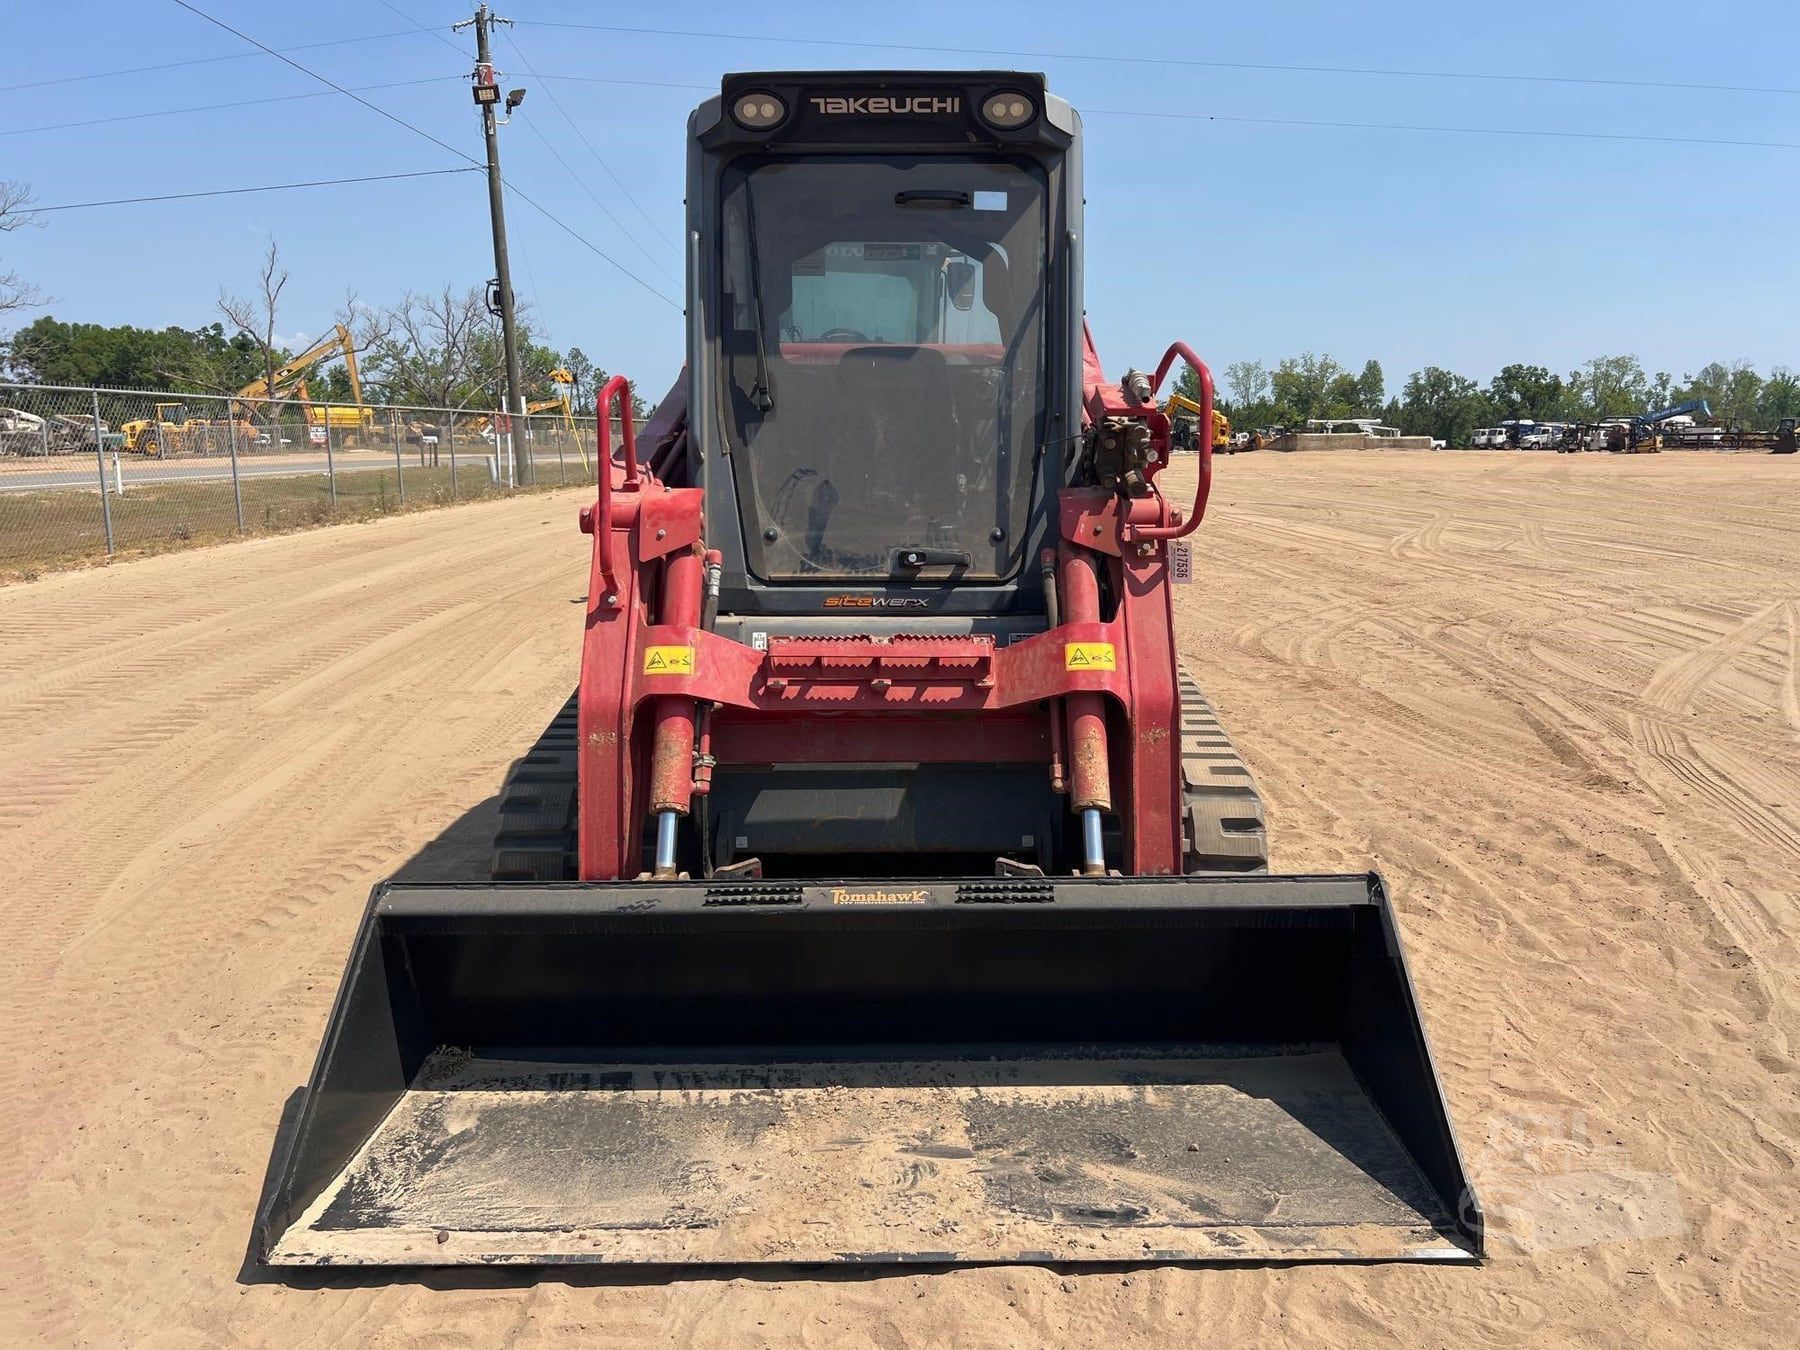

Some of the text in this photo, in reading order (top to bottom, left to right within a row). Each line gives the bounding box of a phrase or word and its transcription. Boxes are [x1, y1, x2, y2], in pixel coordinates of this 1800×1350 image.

[810, 97, 960, 114] TAKEUCHI
[1177, 548, 1188, 578] 217536
[823, 594, 930, 608] sitewerx
[830, 887, 929, 905] Tomahawk
